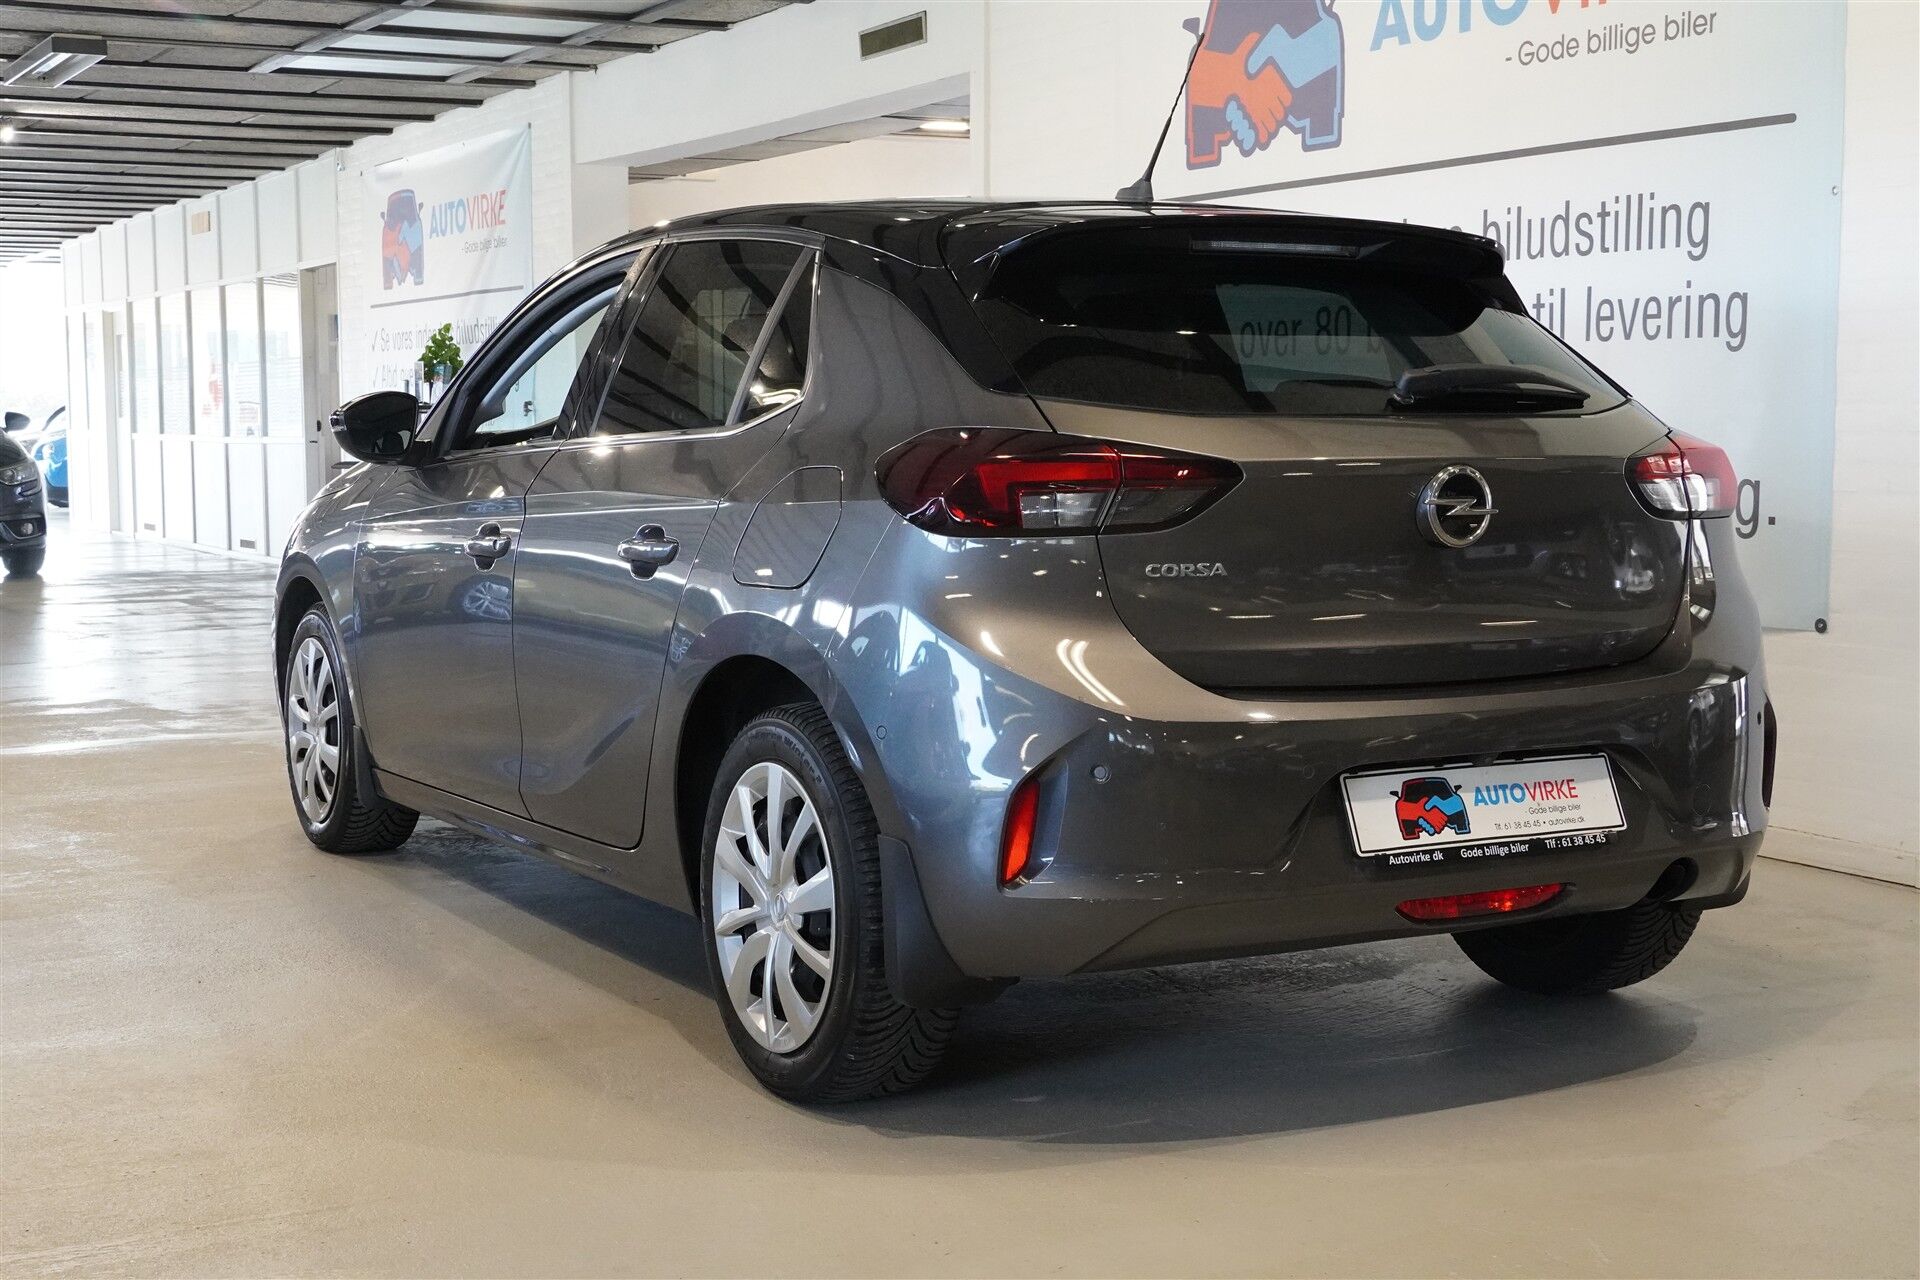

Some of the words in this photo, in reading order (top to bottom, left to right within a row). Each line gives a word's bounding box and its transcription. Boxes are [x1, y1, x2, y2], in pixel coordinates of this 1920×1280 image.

[1518, 34, 1580, 66] Gode
[1586, 22, 1656, 54] billige
[1664, 11, 1717, 41] biler
[429, 189, 507, 239] AUTOVIRKE
[1240, 319, 1303, 358] over
[1315, 305, 1352, 355] 80
[1585, 280, 1749, 352] levering
[1145, 562, 1228, 578] CORSA
[1474, 778, 1579, 806] AUTOVIRKE
[1528, 806, 1548, 815] Gode
[1389, 852, 1431, 866] Autovirke
[1432, 850, 1445, 861] dk
[1460, 848, 1484, 859] Gode
[1484, 844, 1510, 857] billige
[1510, 842, 1529, 854] biler
[1562, 836, 1572, 847] 61
[1573, 835, 1584, 846] 38
[1584, 834, 1595, 845] 45
[1595, 832, 1607, 844] 45
